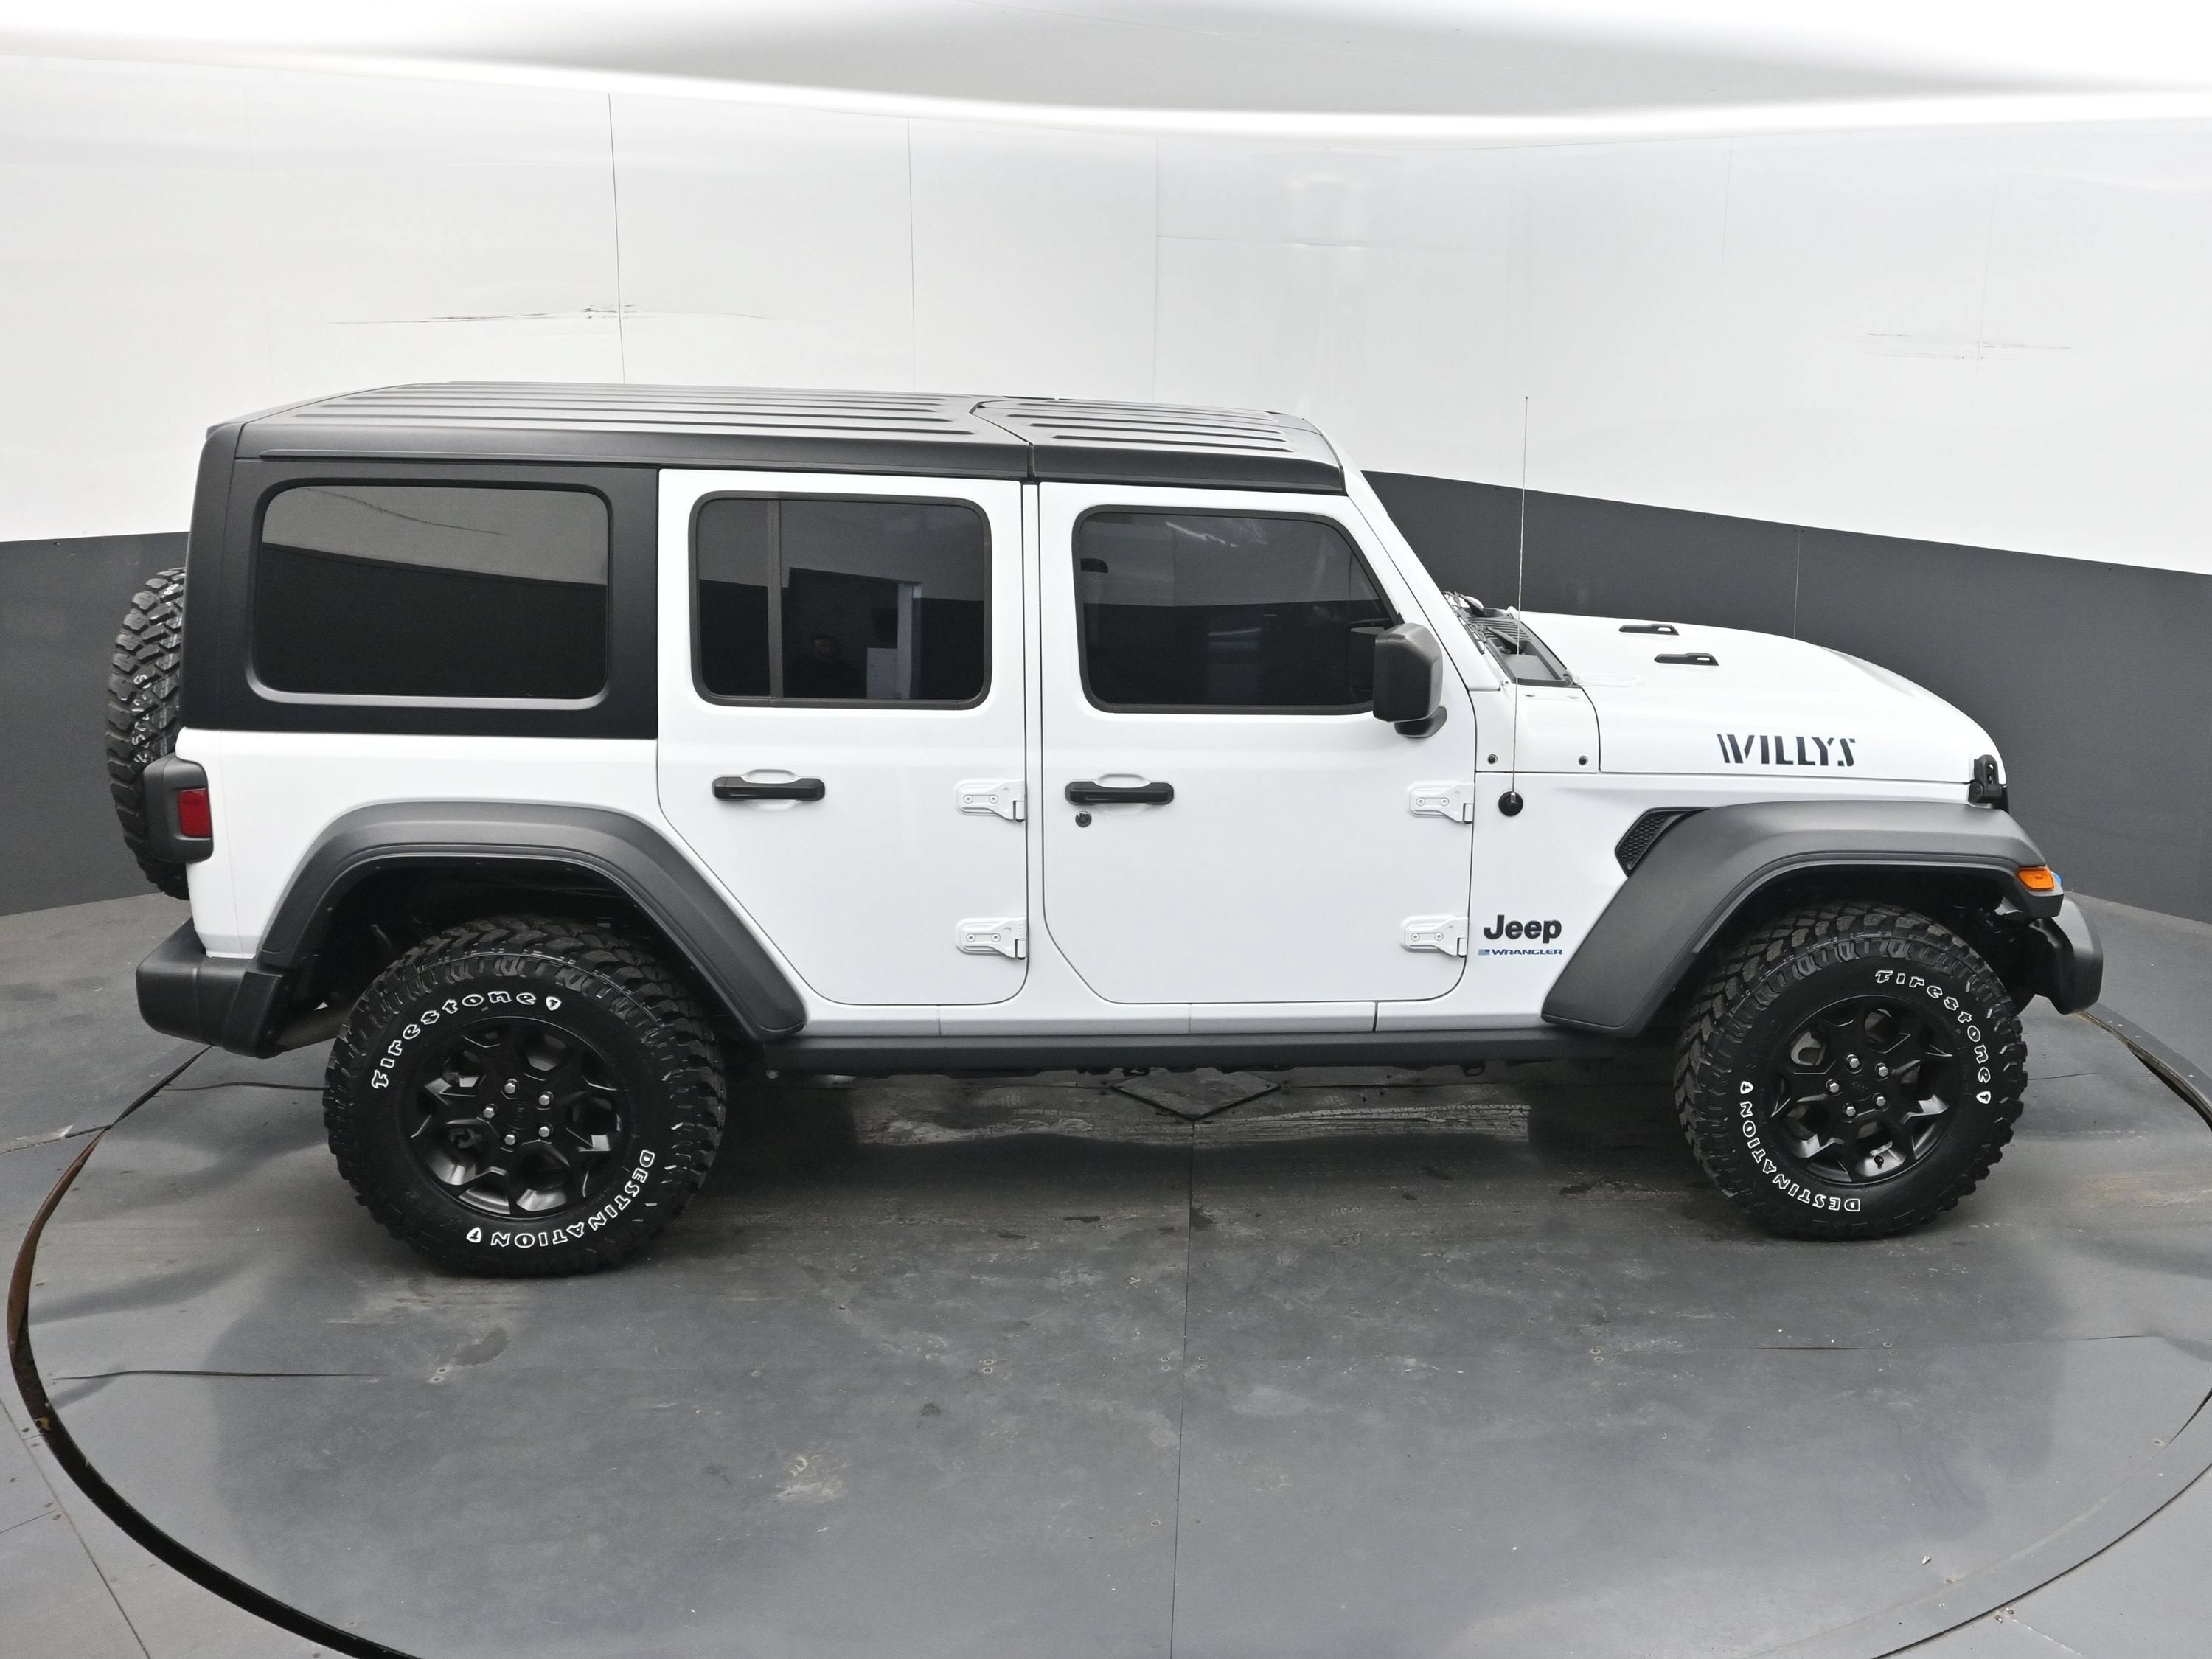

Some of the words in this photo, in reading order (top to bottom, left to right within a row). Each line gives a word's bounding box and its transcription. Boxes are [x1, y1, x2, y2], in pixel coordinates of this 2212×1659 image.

[1717, 734, 1857, 767] WILLYS
[1484, 914, 1562, 944] Jeep
[372, 990, 537, 1089] Firestone
[1874, 969, 1992, 1084] Firestone
[490, 1149, 655, 1248] DESTINATION
[1740, 1100, 1861, 1213] DESTINATION
